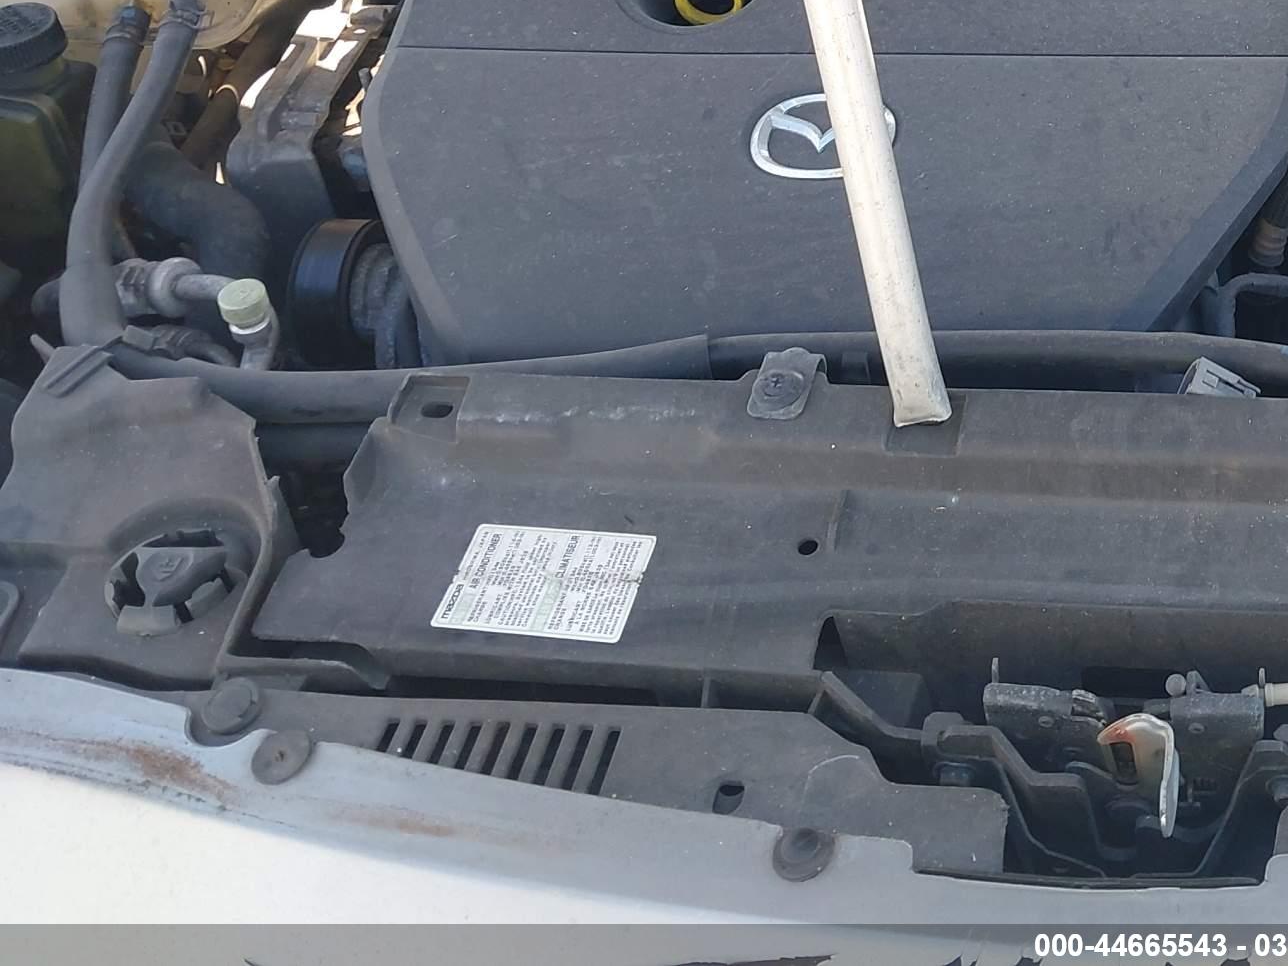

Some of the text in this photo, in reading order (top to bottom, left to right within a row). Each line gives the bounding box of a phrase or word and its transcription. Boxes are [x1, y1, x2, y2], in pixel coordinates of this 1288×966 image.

[470, 577, 479, 589] AIR
[476, 533, 501, 577] CONDITIONER
[556, 535, 580, 578] CLIMATISEUR
[441, 584, 463, 619] mazda
